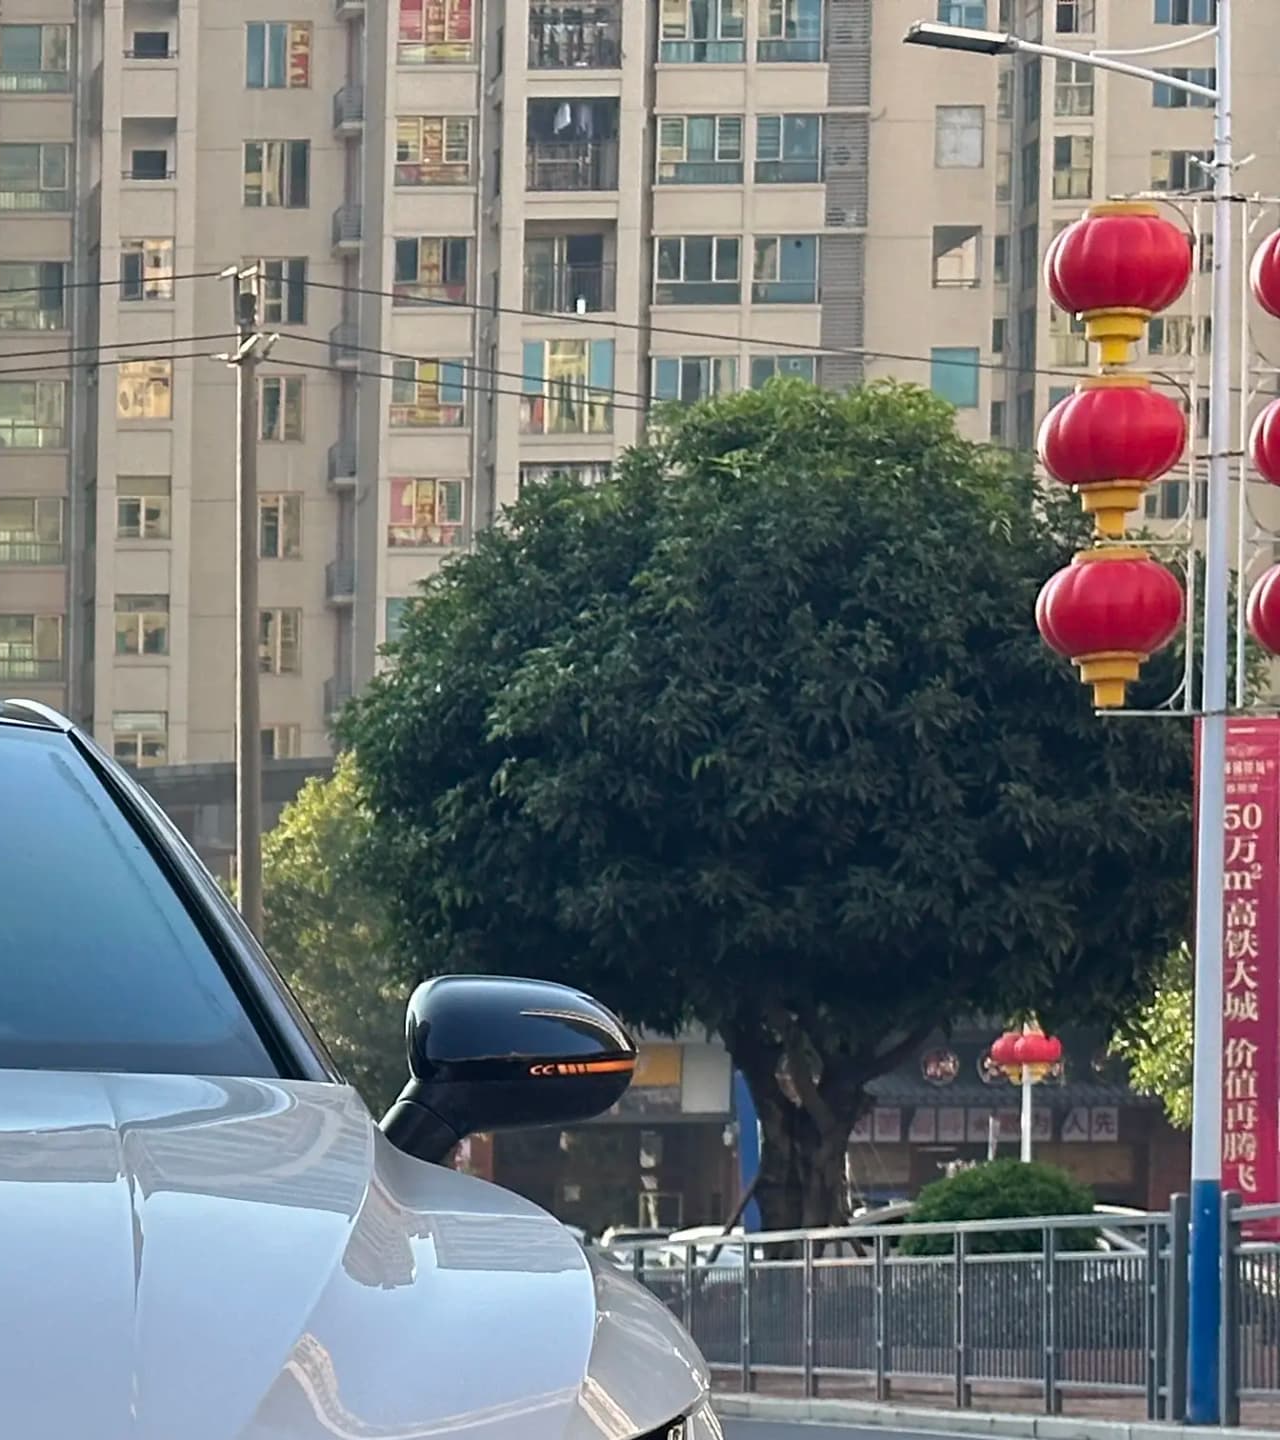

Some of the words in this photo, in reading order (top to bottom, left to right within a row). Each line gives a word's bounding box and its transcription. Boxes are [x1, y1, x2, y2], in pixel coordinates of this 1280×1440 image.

[1224, 1038, 1258, 1192] 价值再腾飞
